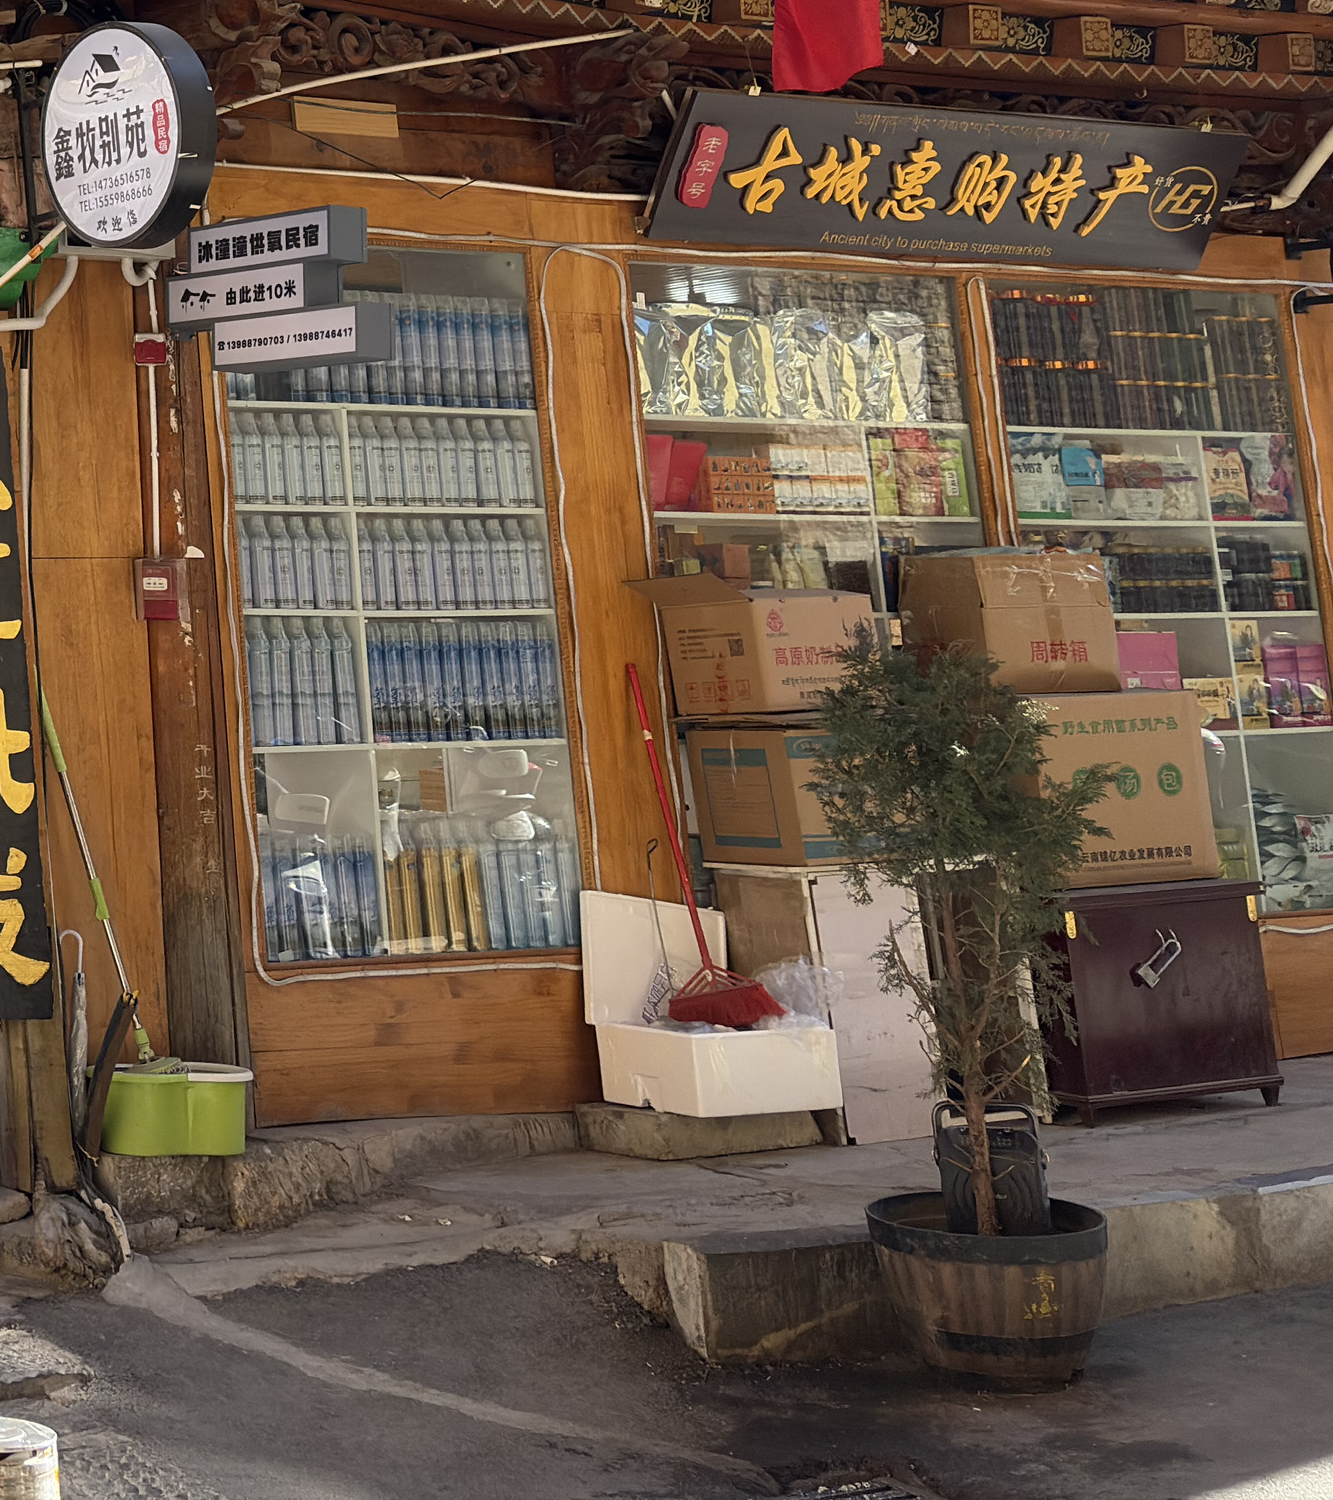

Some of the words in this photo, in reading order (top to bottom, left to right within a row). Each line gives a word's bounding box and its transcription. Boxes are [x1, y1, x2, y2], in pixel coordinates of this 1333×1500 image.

[52, 105, 148, 182] 鑫牧别苑
[78, 167, 152, 197] TEL:14736516578
[686, 136, 723, 199] 老字号
[726, 125, 1155, 238] 古城惠购特产
[79, 185, 153, 213] TEL:15559868666
[820, 230, 869, 248] Ancient
[870, 233, 894, 252] city
[895, 236, 908, 249] to
[909, 237, 968, 255] purchase
[969, 240, 1053, 258] supermarkets
[225, 280, 297, 306] 由此进10米
[1030, 640, 1089, 663] 周转箱
